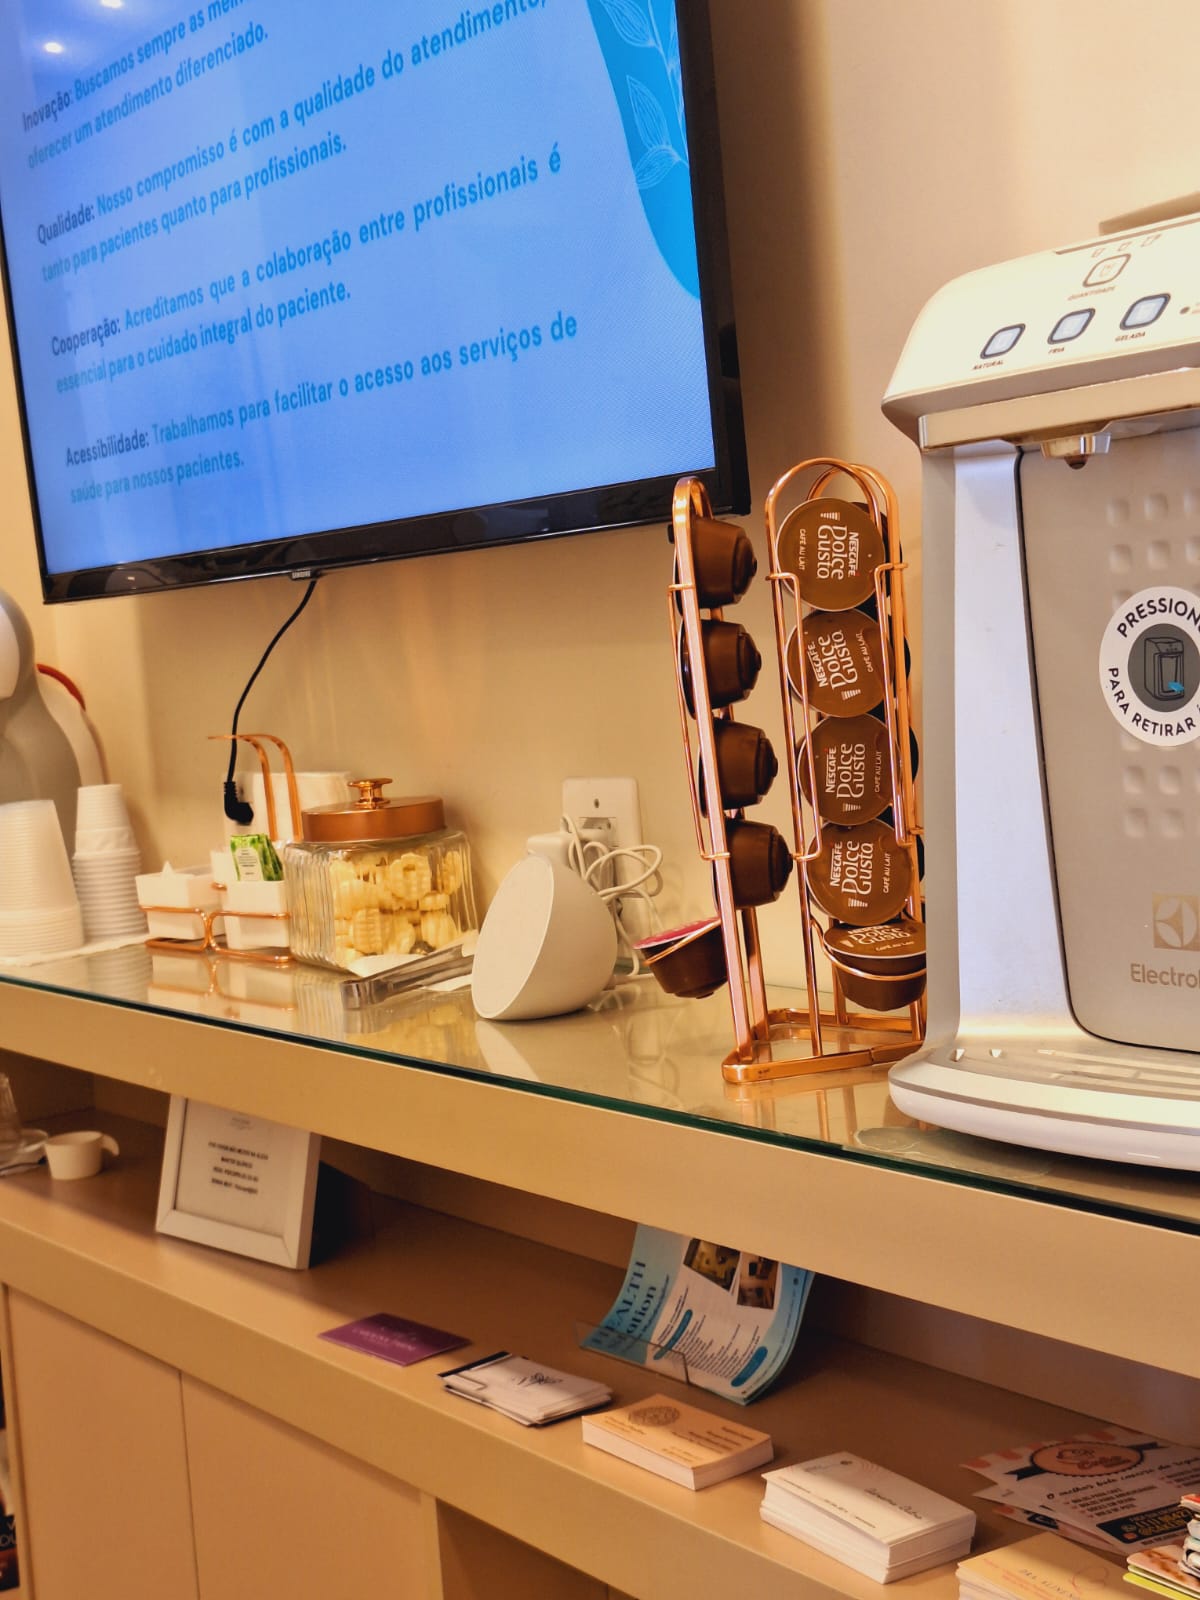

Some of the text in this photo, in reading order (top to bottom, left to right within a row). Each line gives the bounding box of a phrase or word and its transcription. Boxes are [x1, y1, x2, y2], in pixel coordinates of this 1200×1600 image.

[22, 91, 74, 132] Inovação:
[74, 52, 135, 101] Buscamos
[136, 21, 186, 66] sempre
[189, 10, 204, 32] as
[28, 21, 269, 169] oferecer um atendimento diferenciado.
[37, 204, 96, 246] Qualidade:
[97, 185, 133, 217] Nosso
[136, 140, 225, 198] compromisso
[229, 128, 238, 152] é
[242, 116, 275, 146] com
[280, 110, 289, 129] a
[294, 64, 375, 127] qualidade
[382, 49, 404, 80] do
[42, 131, 347, 283] tanto para pacientes quanto para profissionais.
[52, 142, 561, 356] Cooperação: Acreditamos que a colaboração entre profissionais é
[56, 279, 351, 394] essencial para o cuidado integral do paciente.
[66, 310, 577, 468] Acessibilidade: Trabalhamos para facilitar o acesso aos serviços de
[70, 449, 245, 504] saúde para nossos pacientes.
[817, 525, 832, 579] Gusto
[831, 525, 848, 580] Dolce
[1116, 597, 1200, 638] PRESSION
[818, 634, 847, 690] Dolce
[832, 630, 858, 684] Gusto
[1108, 667, 1196, 737] PARA RETIRAR
[836, 743, 853, 799] Dolce
[852, 743, 866, 798] Gusto
[841, 840, 860, 893] Dolce
[857, 842, 874, 895] Gusto
